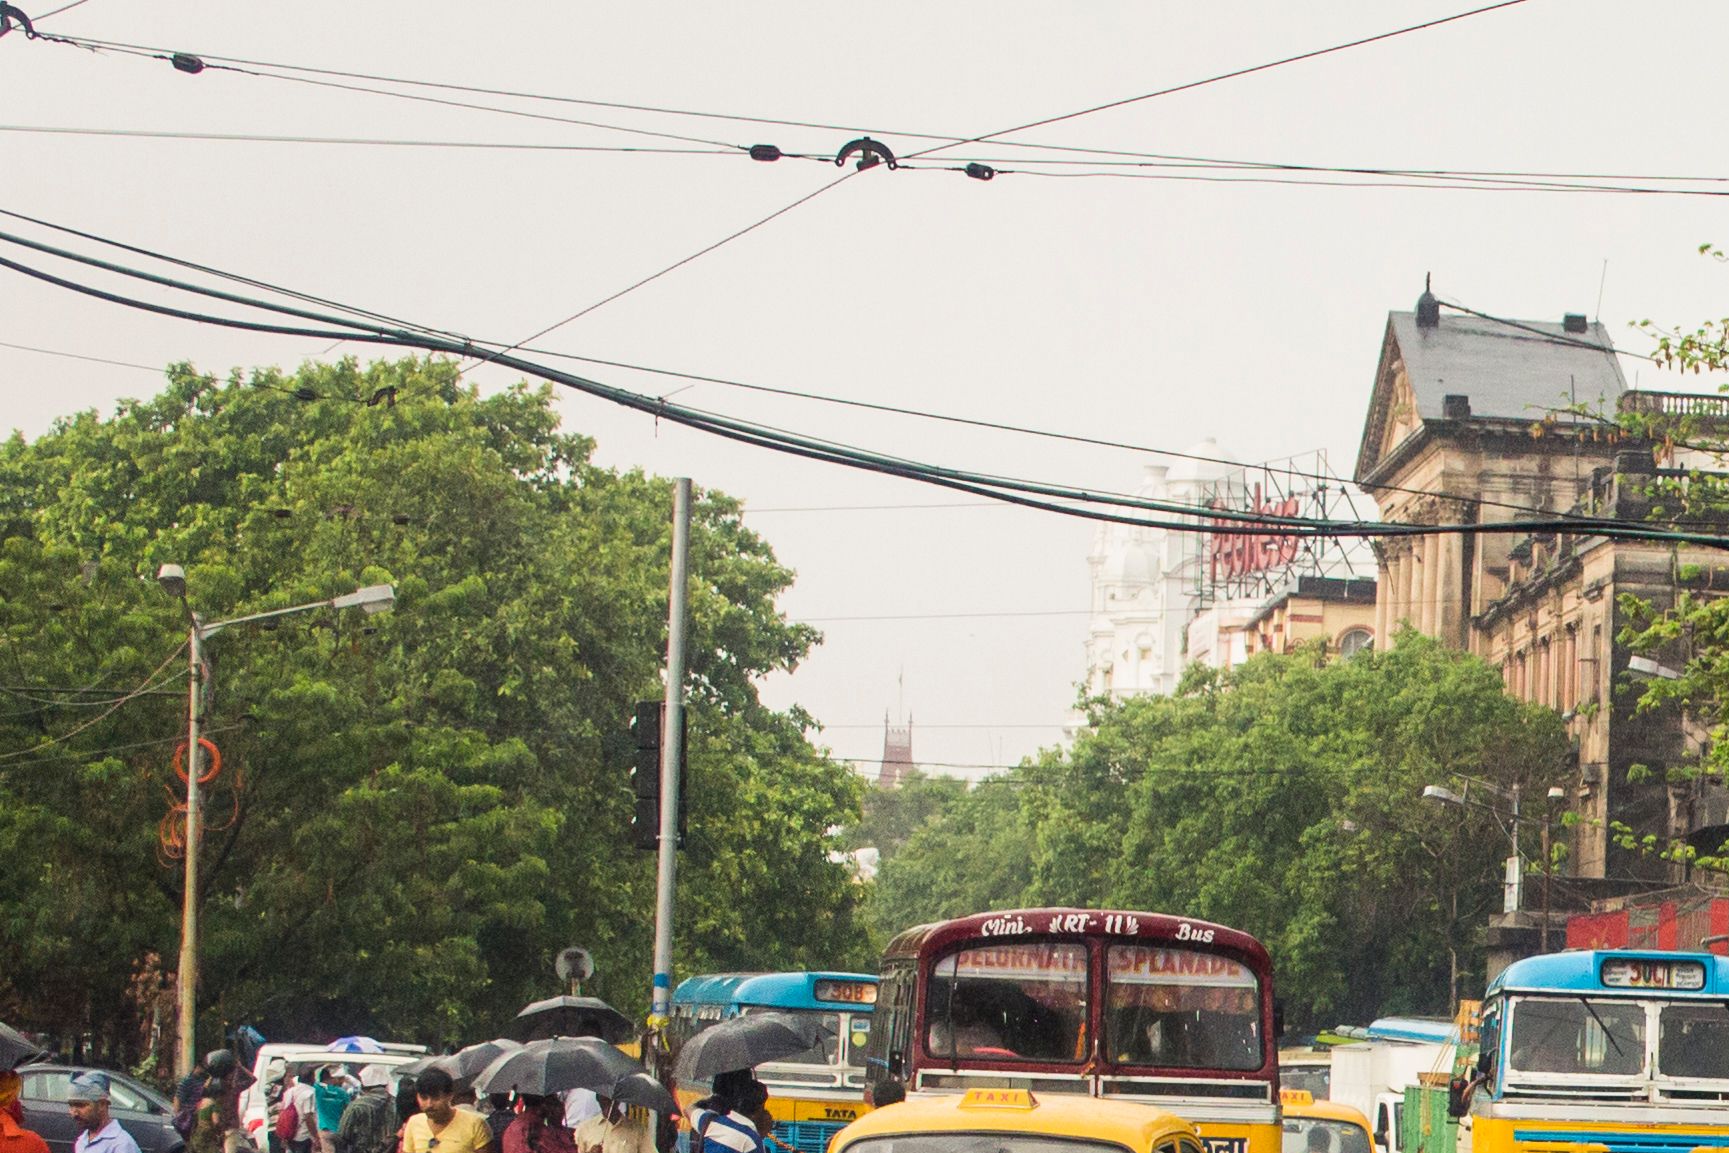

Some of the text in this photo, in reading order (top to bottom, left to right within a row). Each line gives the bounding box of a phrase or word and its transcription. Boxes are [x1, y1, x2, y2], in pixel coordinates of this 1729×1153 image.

[981, 914, 1032, 936] Mini
[1175, 923, 1215, 943] Bus
[1107, 949, 1241, 976] SPLANADE
[974, 1091, 1018, 1102] TAXI
[1280, 1092, 1306, 1101] AXI
[824, 1108, 857, 1119] TATA
